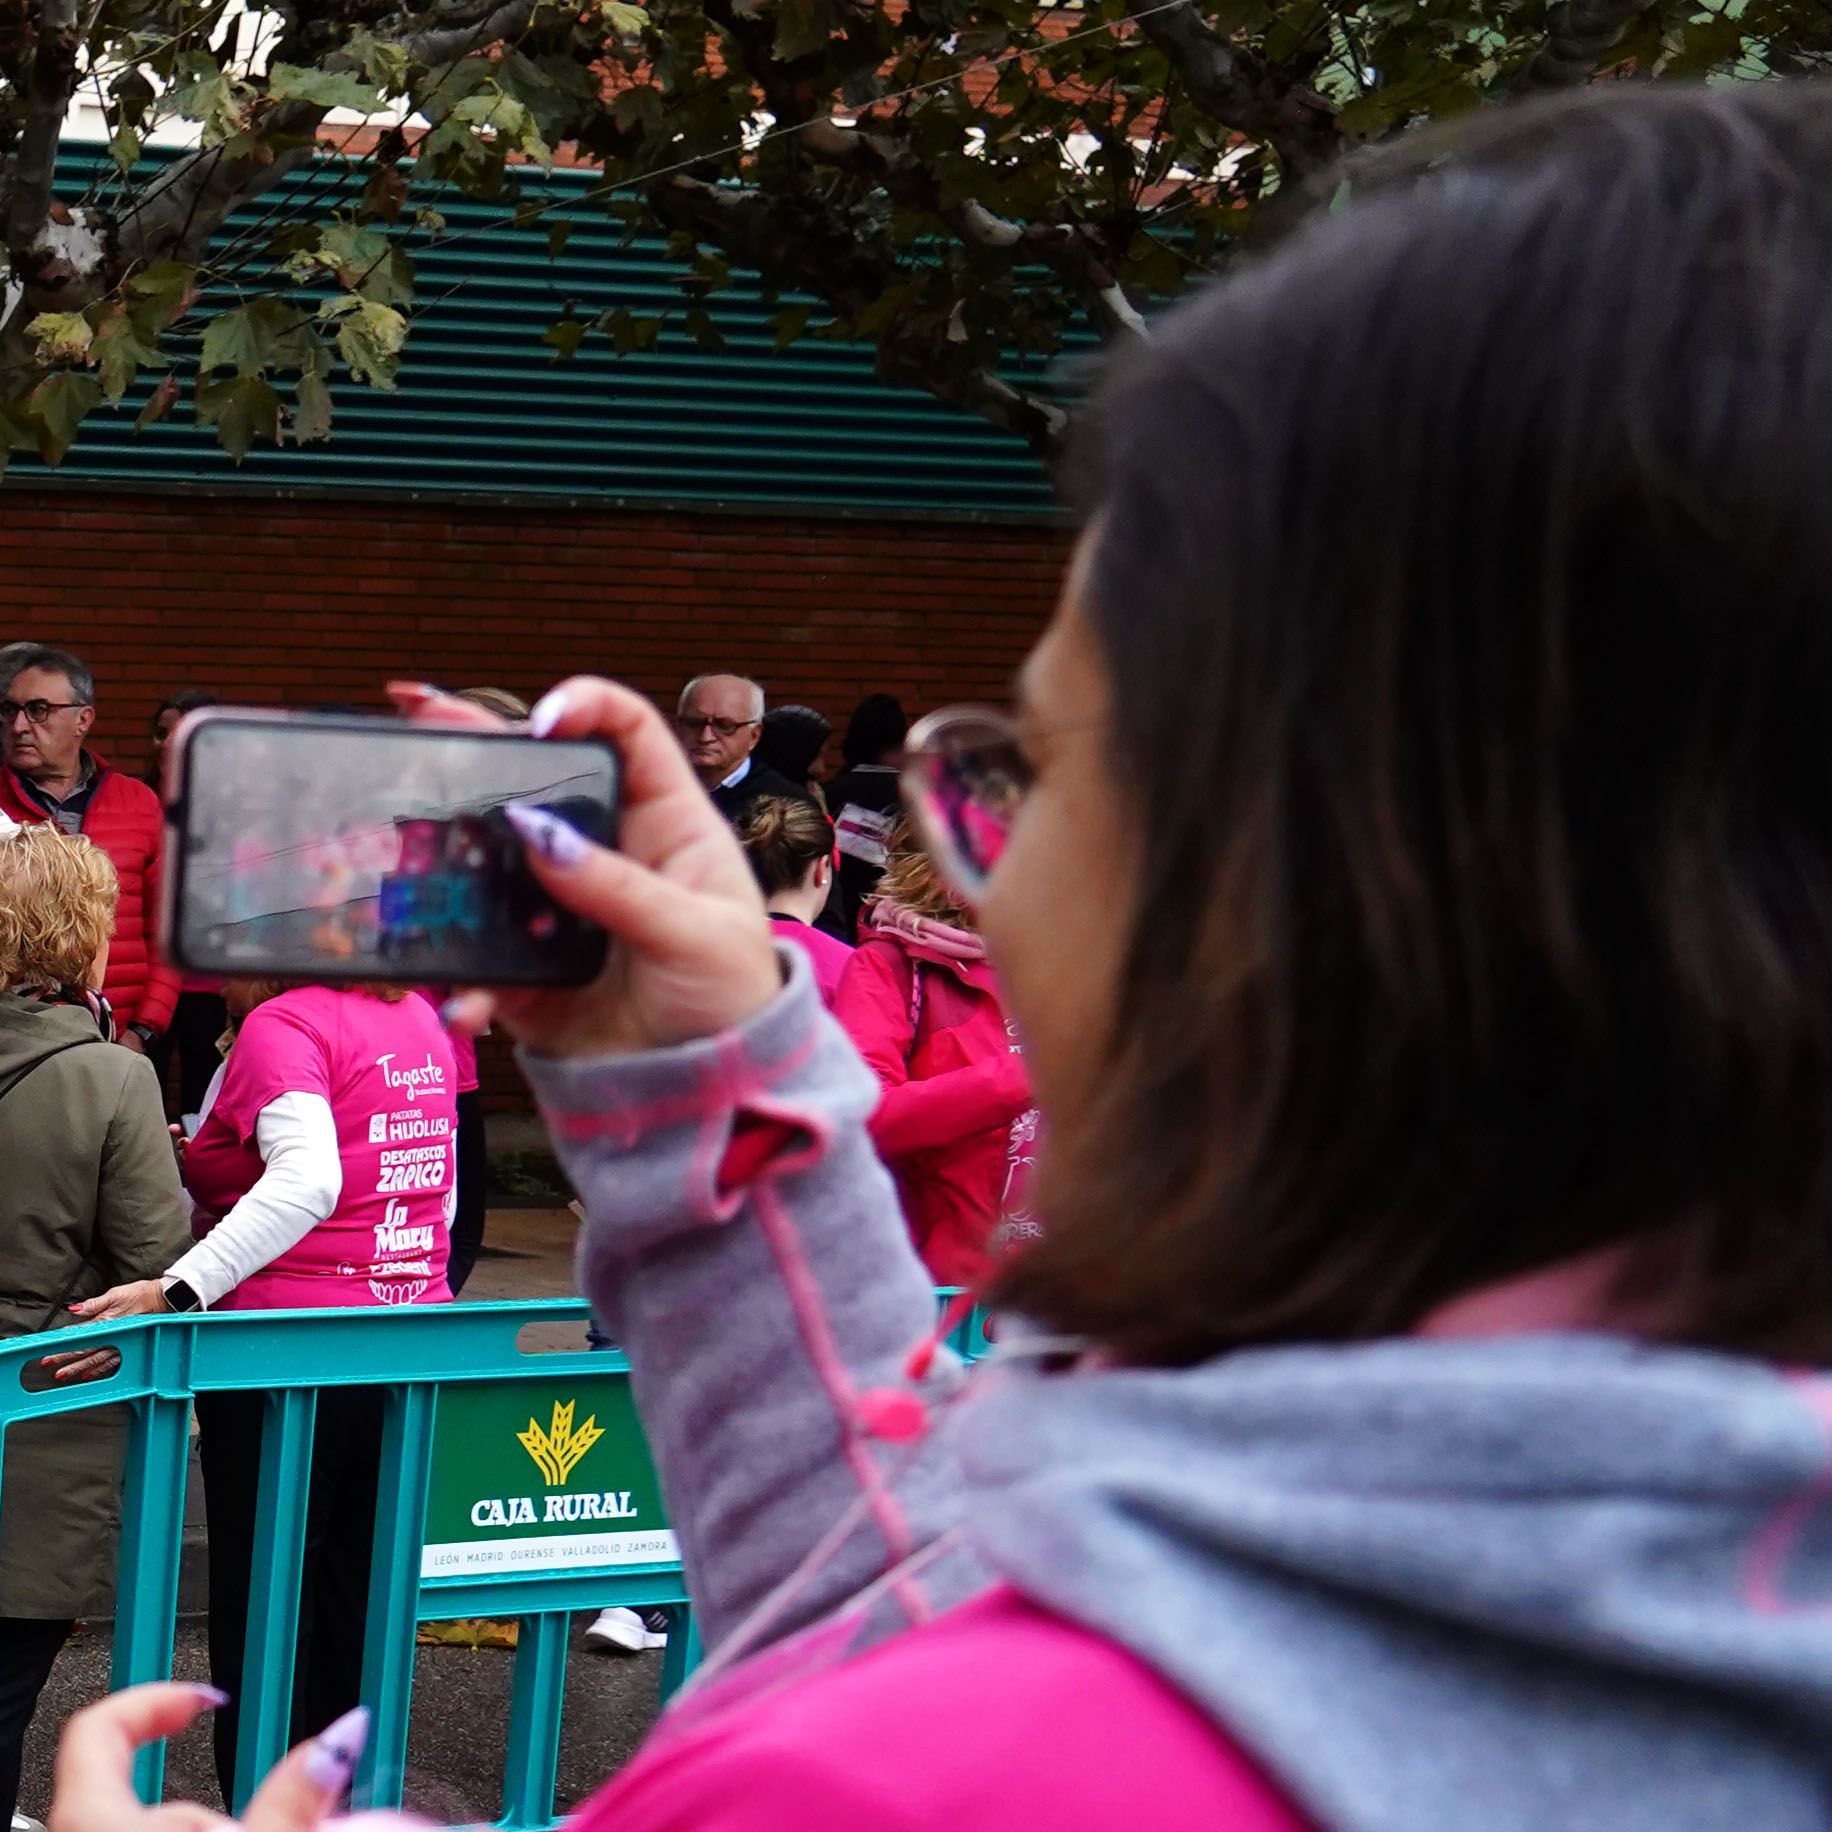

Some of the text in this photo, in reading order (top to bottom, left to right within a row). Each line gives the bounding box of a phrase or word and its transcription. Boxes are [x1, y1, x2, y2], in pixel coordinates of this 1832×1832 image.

[376, 1053, 445, 1101] Tagaste
[389, 1117, 449, 1141] HIJOLUSA
[390, 1109, 424, 1121] PATATAS
[380, 1144, 447, 1166] DESATASCOS
[376, 1160, 446, 1192] ZAPICO
[373, 1224, 434, 1259] Mary
[471, 1491, 638, 1527] CAJA RURAL
[434, 1541, 668, 1566] LEÓN MADRID OURENSE VALLADOLID ZAMORA
